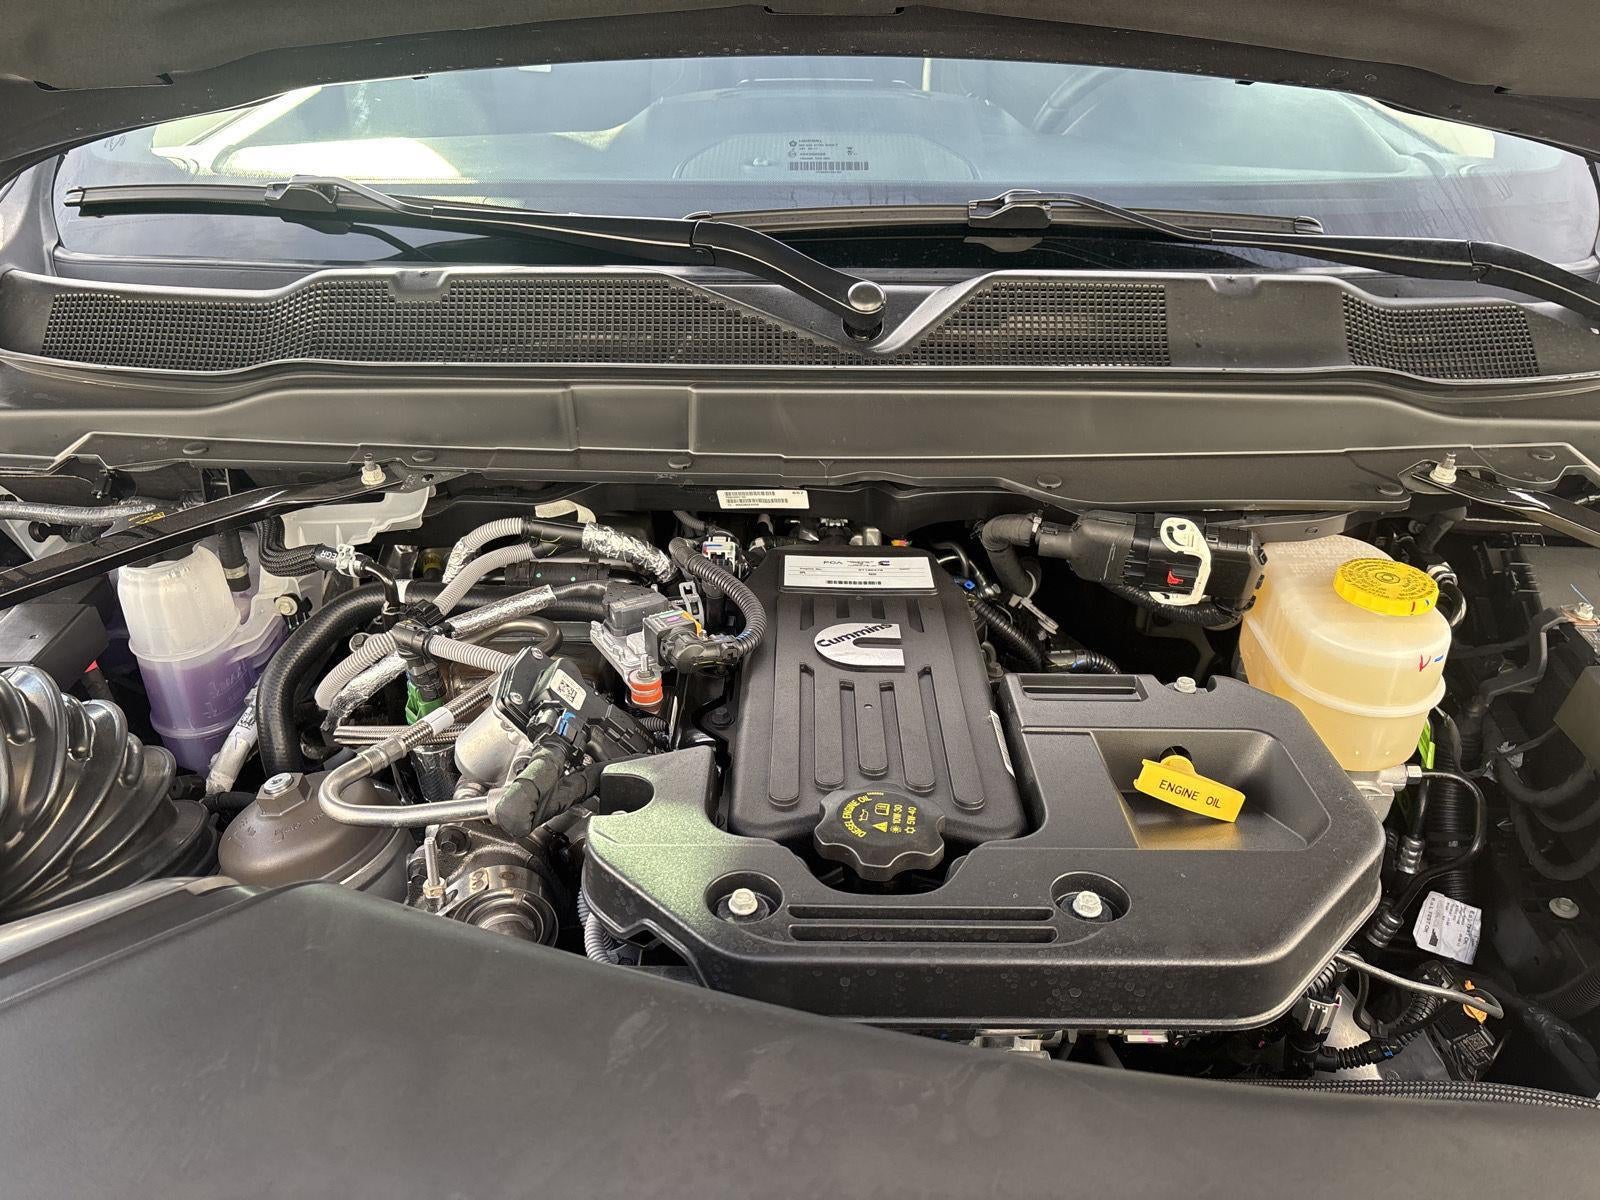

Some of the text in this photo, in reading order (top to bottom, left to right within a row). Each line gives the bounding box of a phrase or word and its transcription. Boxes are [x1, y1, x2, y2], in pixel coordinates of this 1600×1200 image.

[320, 550, 338, 561] EGR
[816, 623, 893, 648] Cummins
[1159, 779, 1221, 809] ENGINE OIL
[842, 800, 860, 819] ENGINE
[857, 795, 873, 804] OIL
